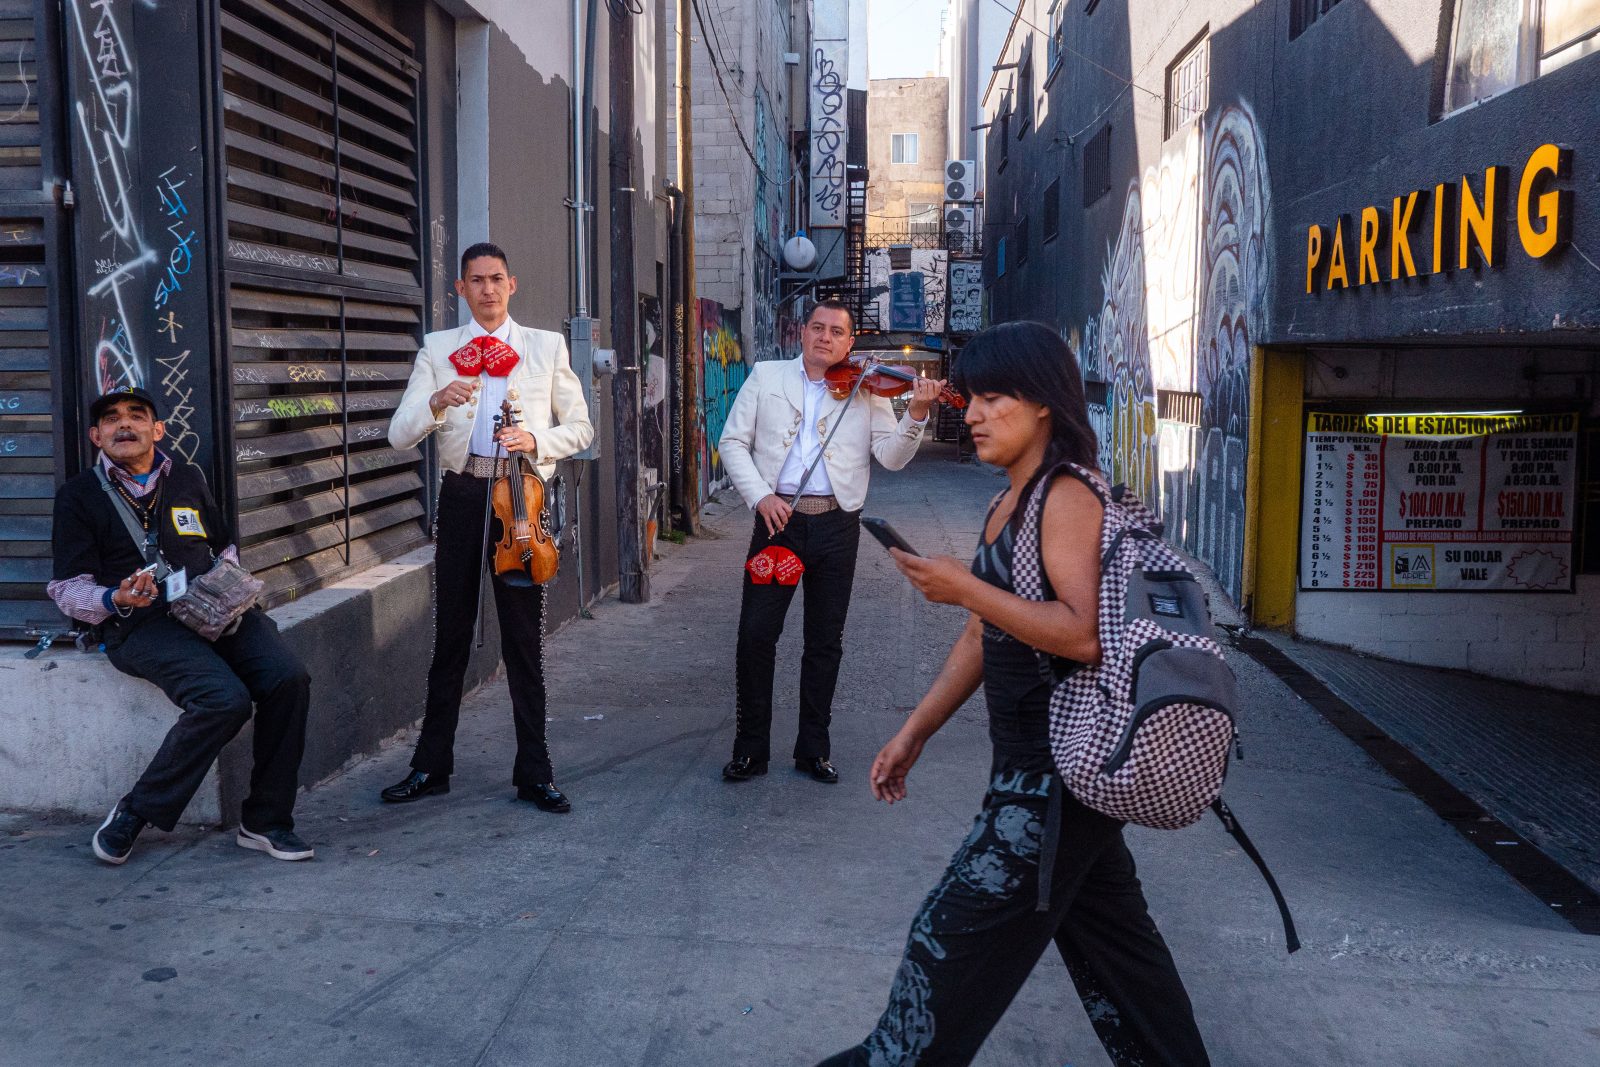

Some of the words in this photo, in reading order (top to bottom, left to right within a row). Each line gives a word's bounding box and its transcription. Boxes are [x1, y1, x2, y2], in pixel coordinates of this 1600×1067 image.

[1306, 143, 1561, 294] PARKING
[1313, 414, 1378, 434] TARIFAS
[1383, 416, 1410, 434] DEL
[1415, 414, 1573, 434] ESTACIONAMIENTO
[1404, 440, 1438, 449] TARIFA
[1440, 440, 1453, 449] DE
[1455, 440, 1473, 449] DIA
[1497, 438, 1512, 448] FIN
[1516, 438, 1529, 448] DE
[1531, 438, 1574, 449] SEMANA
[1413, 451, 1437, 462] 8:00
[1438, 451, 1460, 462] A.M.
[1500, 450, 1507, 462] Y
[1510, 450, 1531, 462] POR
[1532, 450, 1568, 462] NOCHE
[1408, 463, 1415, 474] A
[1417, 463, 1440, 474] 8:00
[1443, 463, 1463, 474] P.M.
[1511, 463, 1535, 474] 8:00
[1536, 463, 1557, 474] P.M.
[1416, 475, 1436, 486] POR
[1438, 475, 1456, 486] DIA
[1504, 475, 1511, 486] A
[1513, 475, 1537, 486] 8:00
[1539, 475, 1561, 486] A.M.
[1400, 490, 1406, 520] $
[1409, 492, 1443, 517] 100.00
[1445, 492, 1466, 517] M.N.
[1497, 490, 1541, 519] $150.00
[1543, 492, 1565, 517] M.N.
[1406, 519, 1462, 529] PREPAGO
[1501, 519, 1560, 529] PREPAGO
[1445, 550, 1461, 563] SU
[1464, 550, 1502, 563] DOLAR
[1460, 568, 1488, 581] VALE
